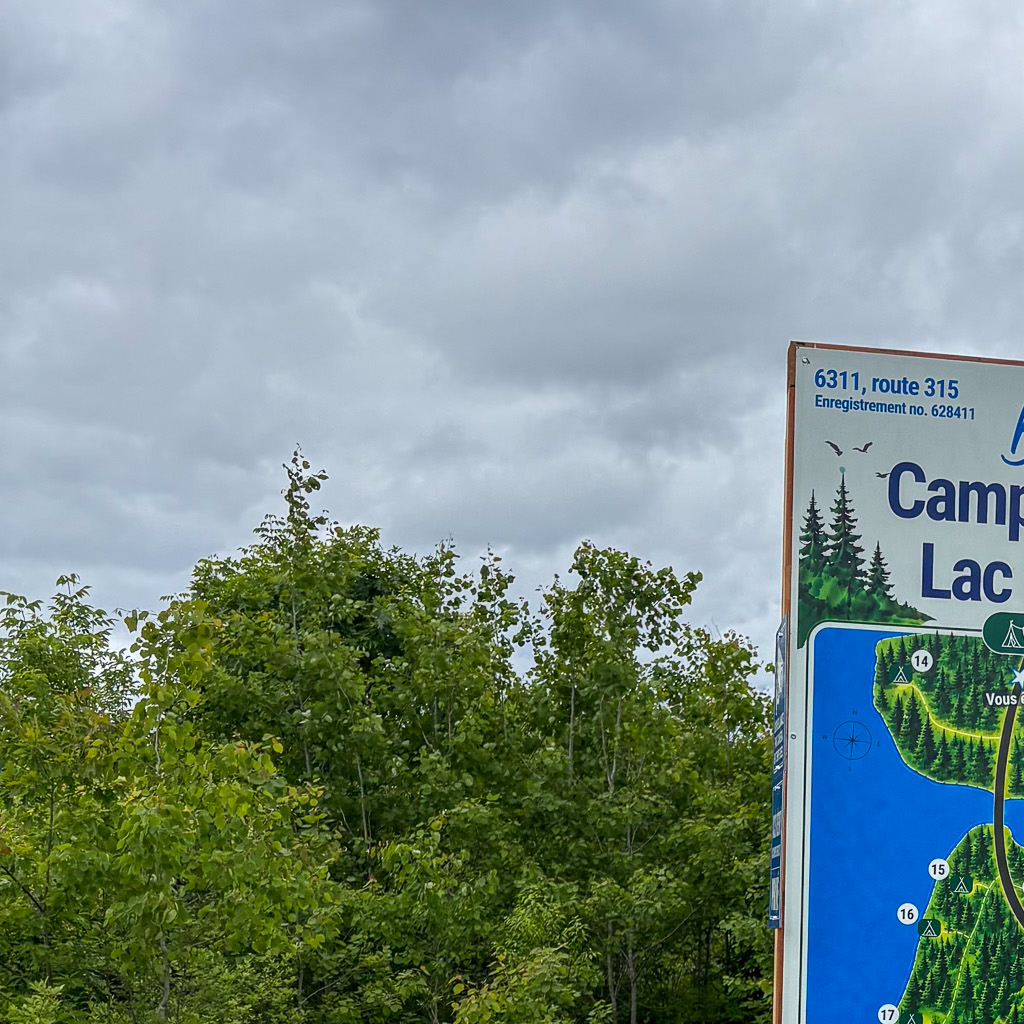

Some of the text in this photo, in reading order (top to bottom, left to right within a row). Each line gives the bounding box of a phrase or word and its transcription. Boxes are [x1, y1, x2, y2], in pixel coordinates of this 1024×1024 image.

[814, 369, 958, 399] 6311, route 315
[815, 395, 975, 420] Enregistrement no. 628411
[921, 542, 1013, 603] Lac
[986, 692, 1017, 705] Vous
